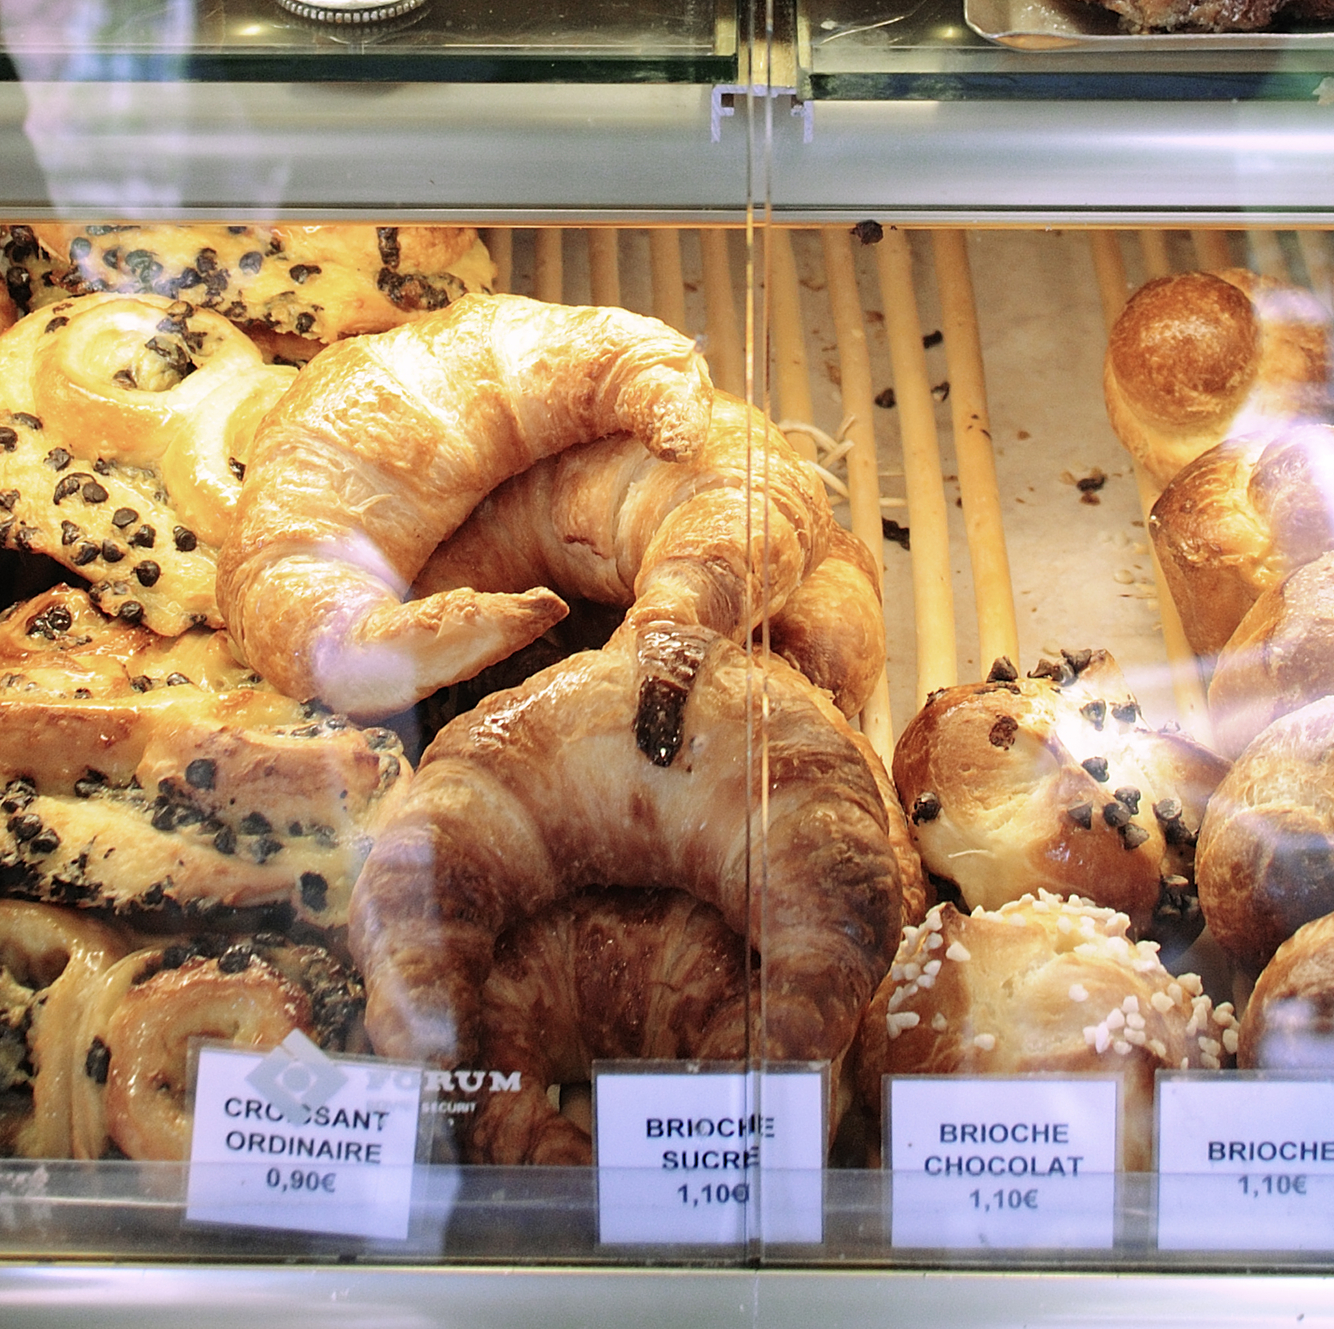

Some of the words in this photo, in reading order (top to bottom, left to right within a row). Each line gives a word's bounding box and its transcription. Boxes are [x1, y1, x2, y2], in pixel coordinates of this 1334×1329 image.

[646, 1113, 775, 1138] BRIOCHE
[939, 1123, 1069, 1144] BRIOCHE
[226, 1130, 382, 1164] ORDINAIRE
[924, 1155, 1084, 1177] CHOCOLAT
[267, 1168, 336, 1193] 0,90€
[1238, 1175, 1307, 1198] 1,10€
[969, 1189, 1039, 1212] 1,10€
